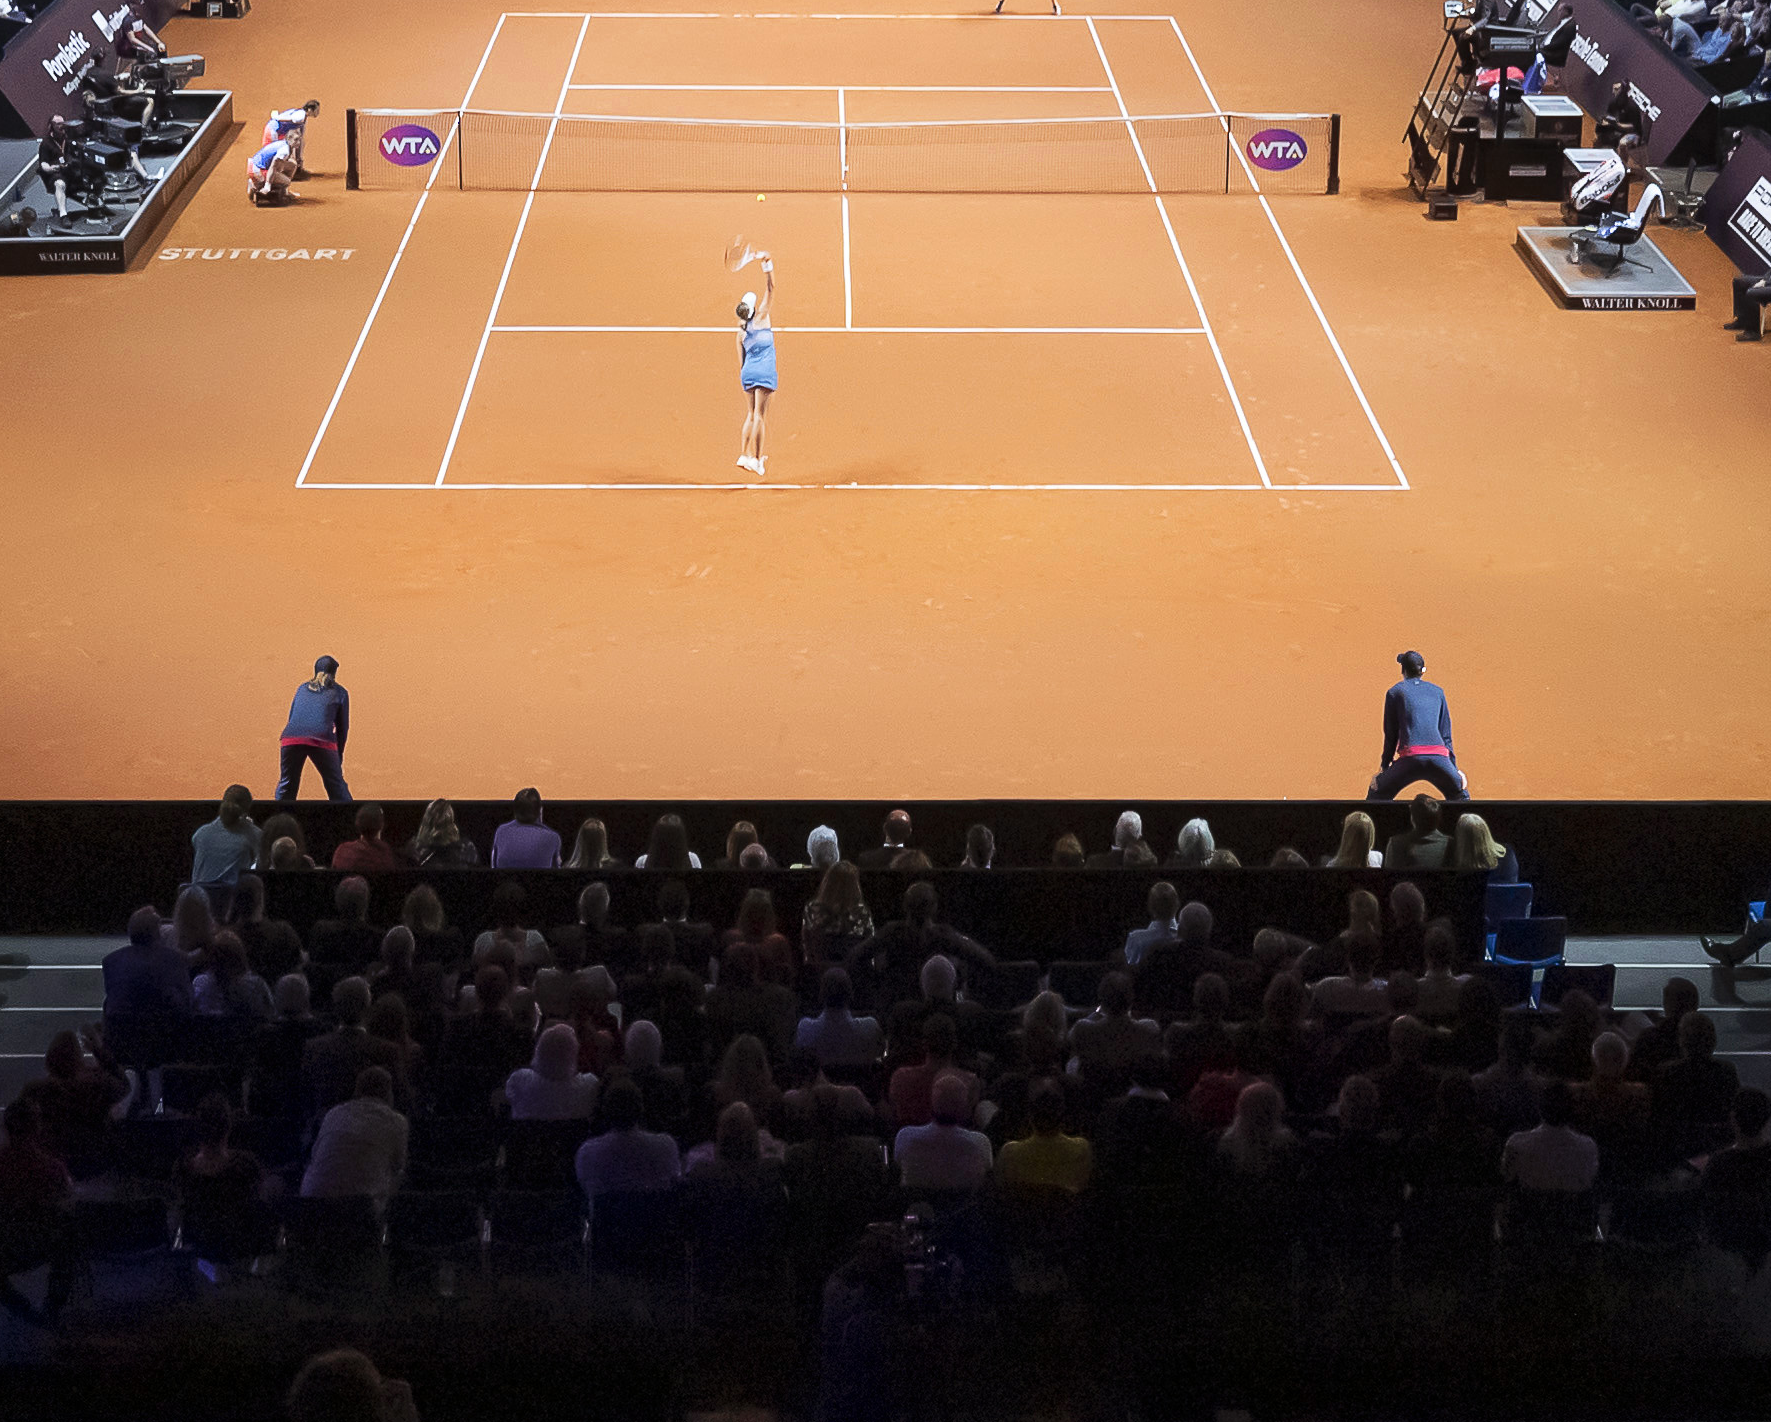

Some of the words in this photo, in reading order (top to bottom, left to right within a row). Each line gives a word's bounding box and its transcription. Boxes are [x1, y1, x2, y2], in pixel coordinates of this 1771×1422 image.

[42, 30, 91, 82] Porplastic
[382, 137, 437, 154] WTA
[1250, 141, 1304, 158] WTA
[39, 252, 80, 263] WALTER
[83, 252, 119, 262] KNOLL
[158, 248, 357, 261] STUTTGART
[1582, 298, 1633, 309] WALTER
[1637, 298, 1682, 309] KNOLL
